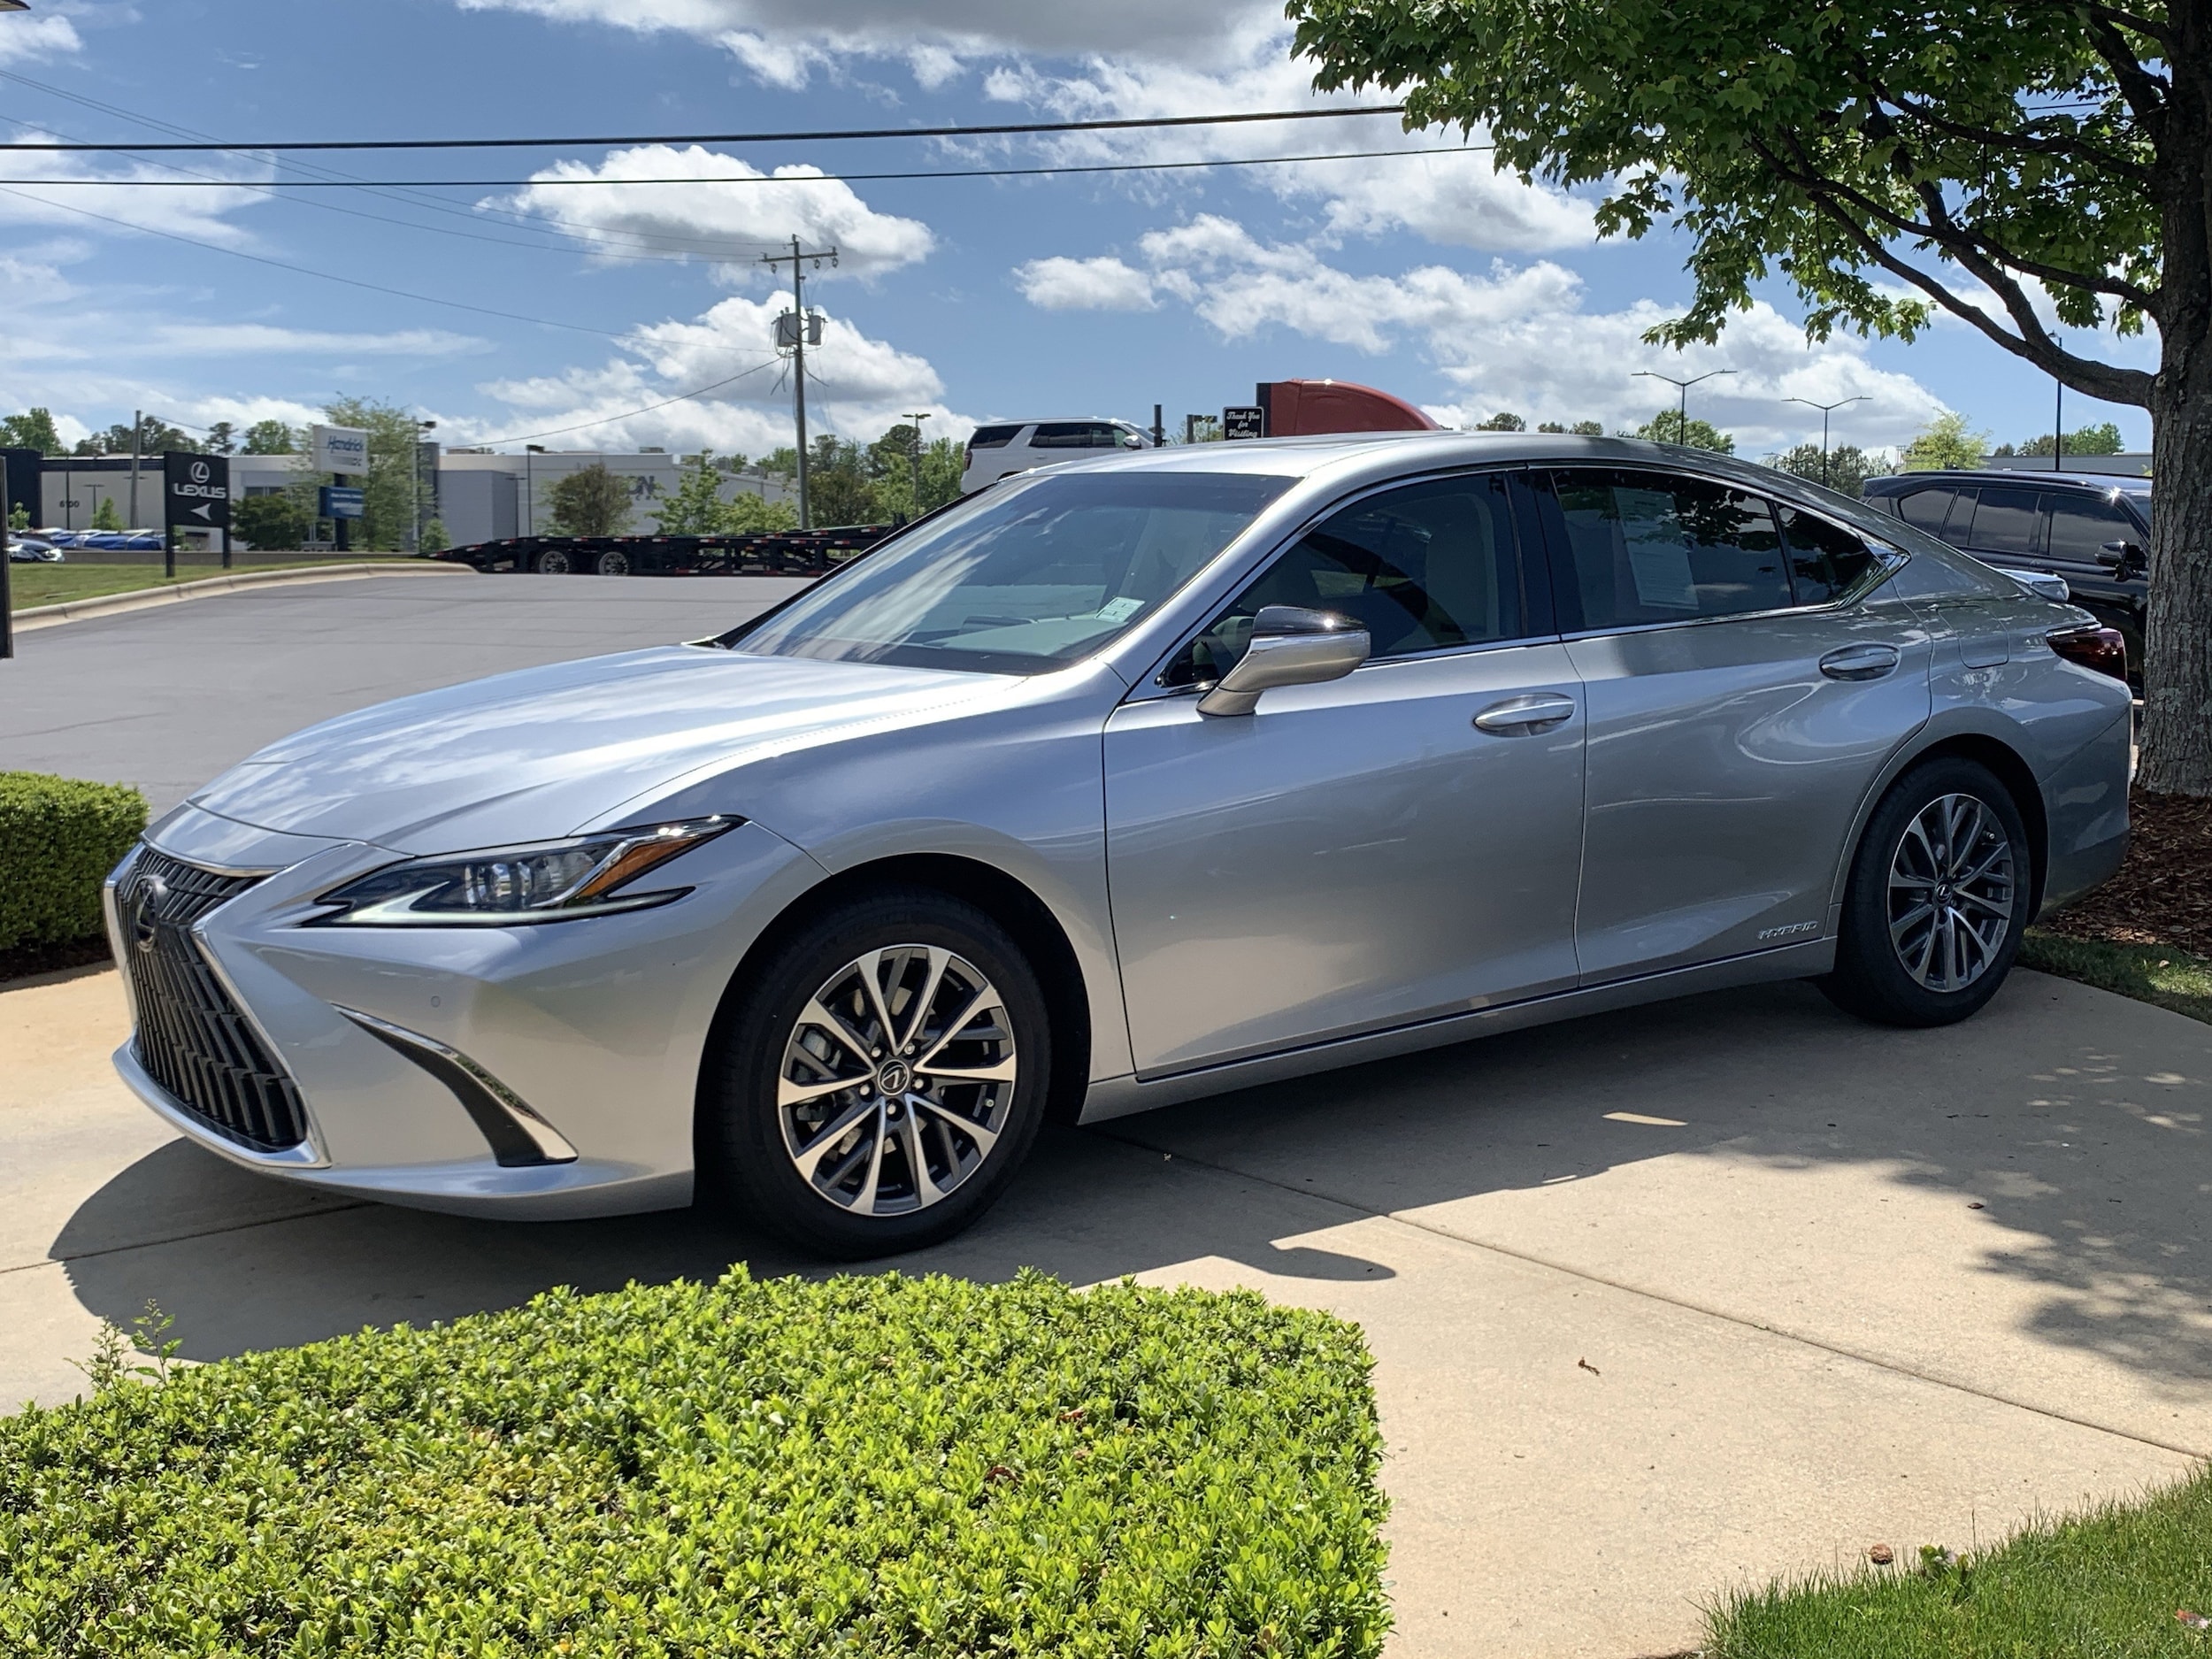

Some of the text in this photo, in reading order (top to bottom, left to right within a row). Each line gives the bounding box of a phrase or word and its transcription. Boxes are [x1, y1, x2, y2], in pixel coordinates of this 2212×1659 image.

[1226, 411, 1260, 422] Thank You
[1237, 420, 1248, 429] for
[173, 483, 227, 499] LEXUS
